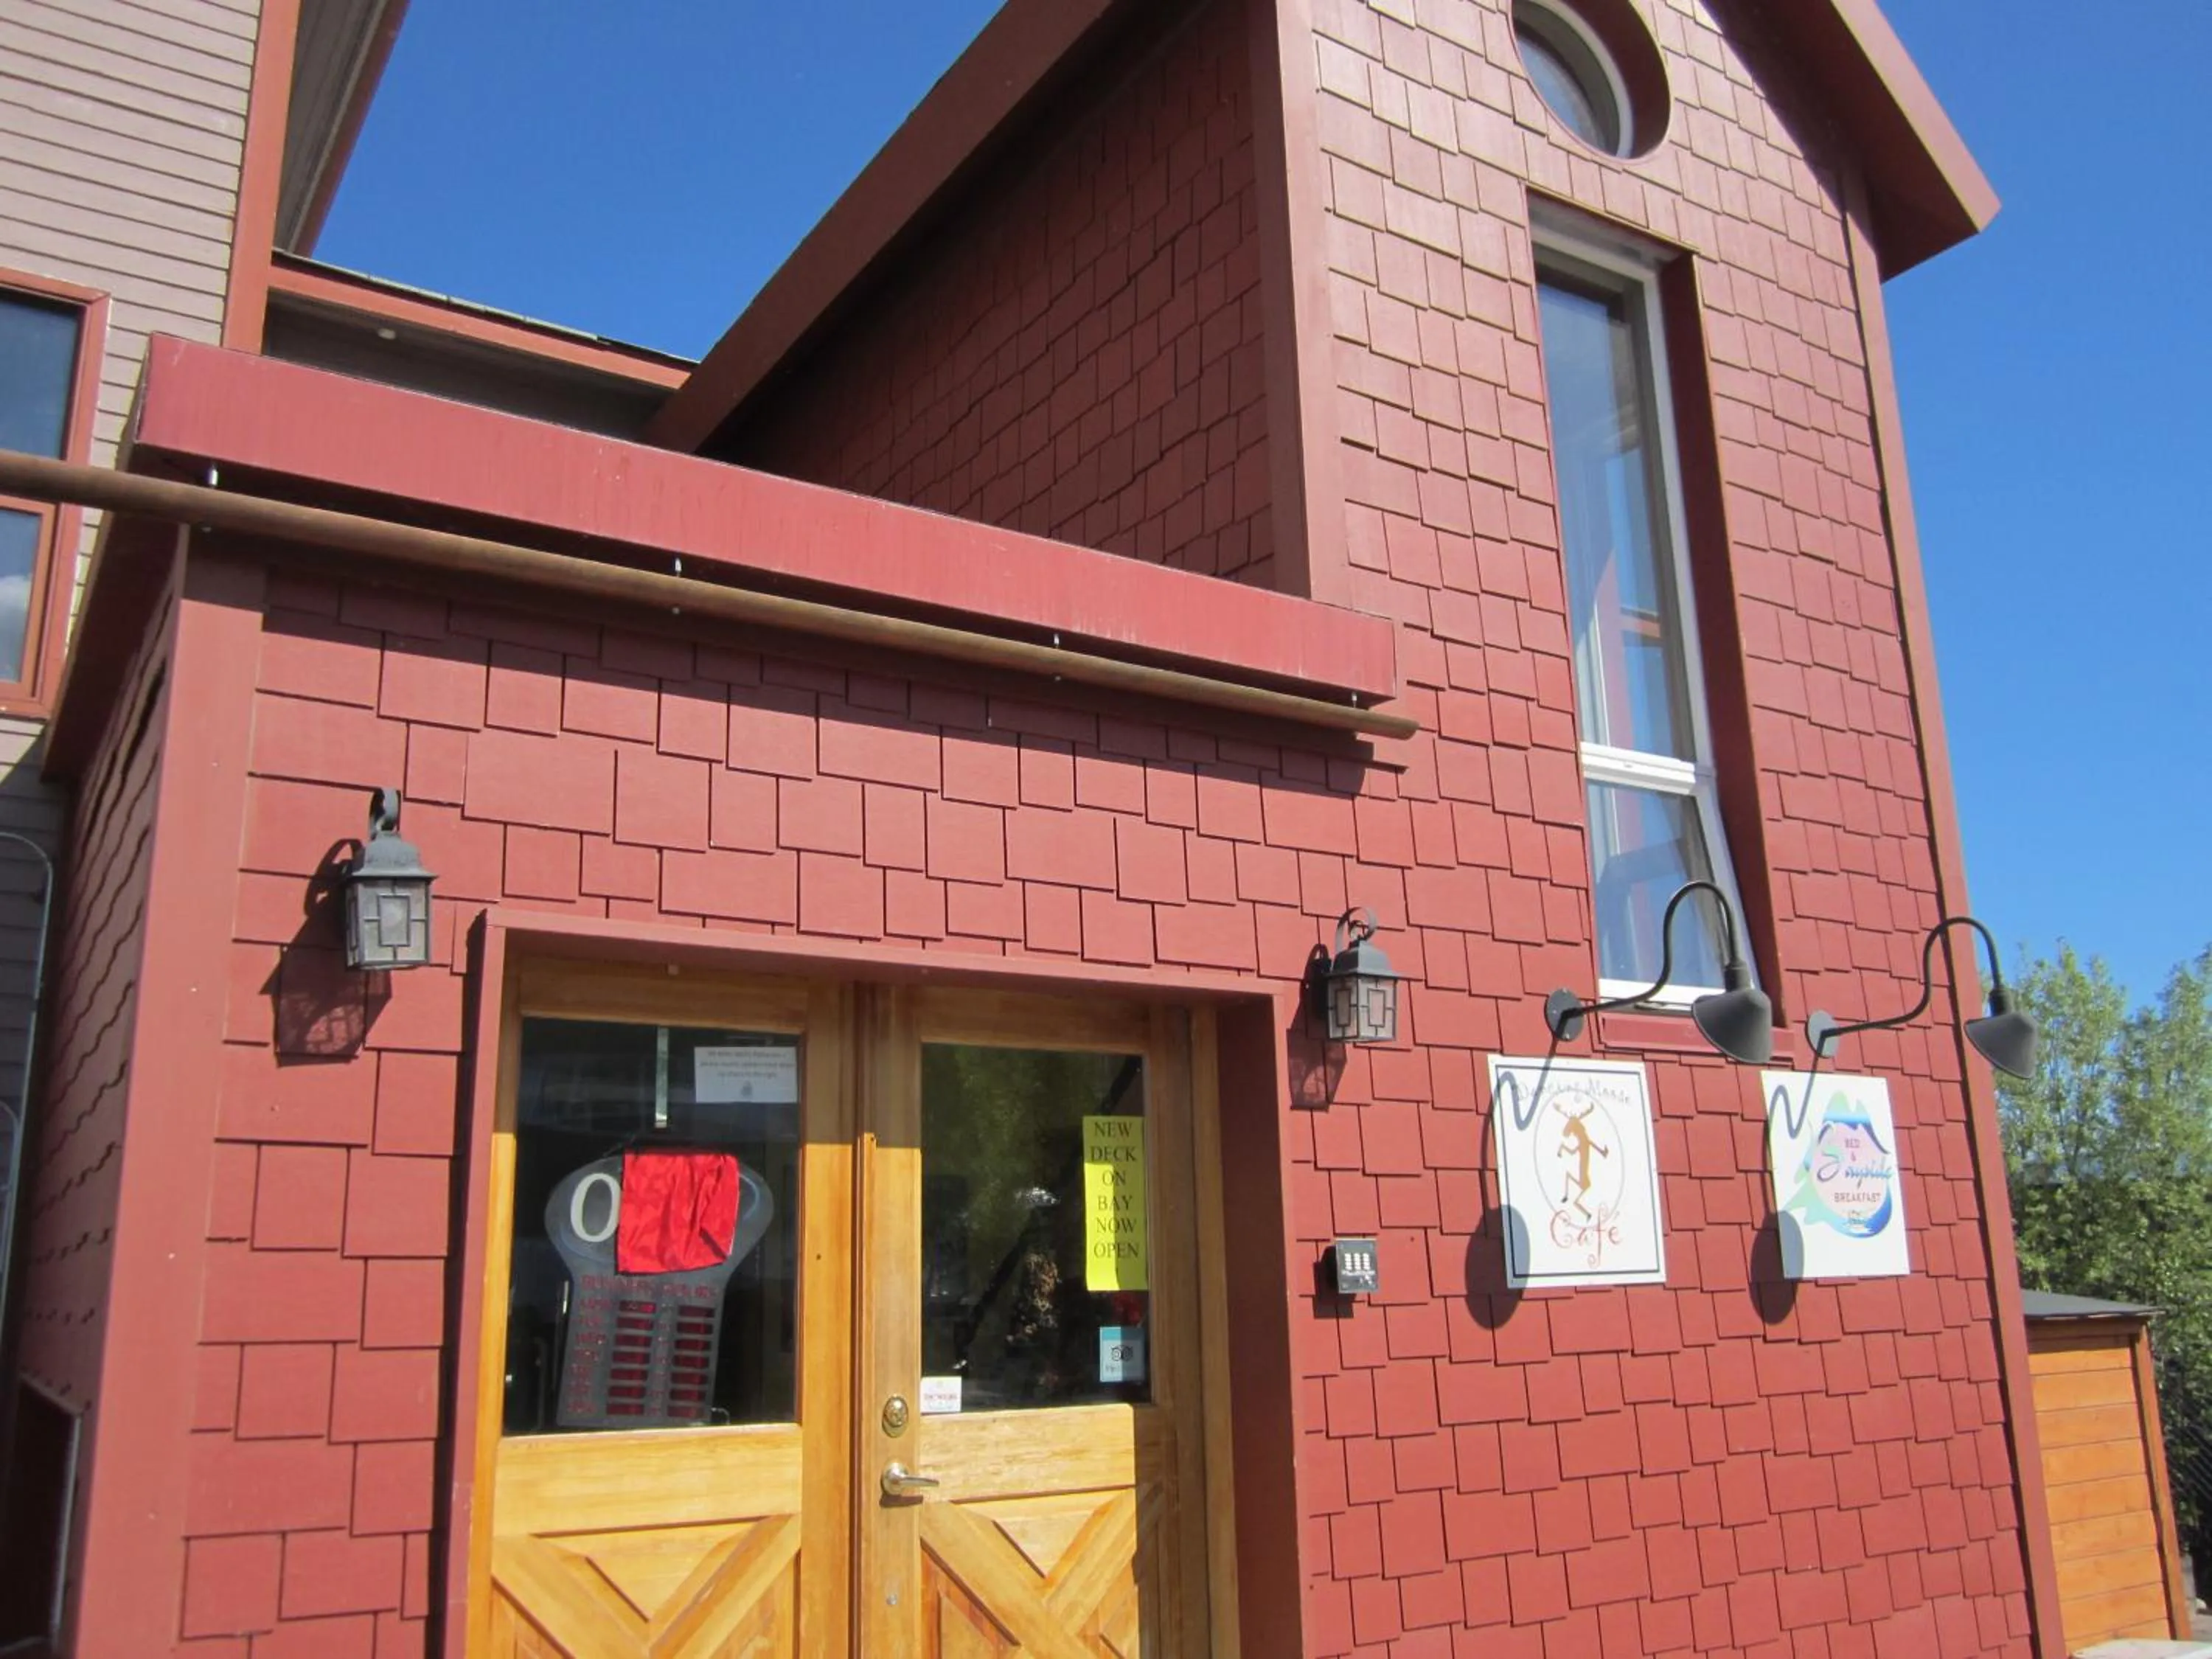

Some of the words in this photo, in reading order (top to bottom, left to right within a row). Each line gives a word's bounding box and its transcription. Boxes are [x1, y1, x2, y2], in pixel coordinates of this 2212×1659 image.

[1094, 1121, 1132, 1138] NEW
[1091, 1146, 1136, 1162] DECK
[1102, 1169, 1126, 1186] ON
[1098, 1195, 1133, 1211] BAY
[1834, 1192, 1881, 1203] BREAKFAST
[1096, 1217, 1136, 1234] NOW
[1093, 1242, 1140, 1259] OPEN
